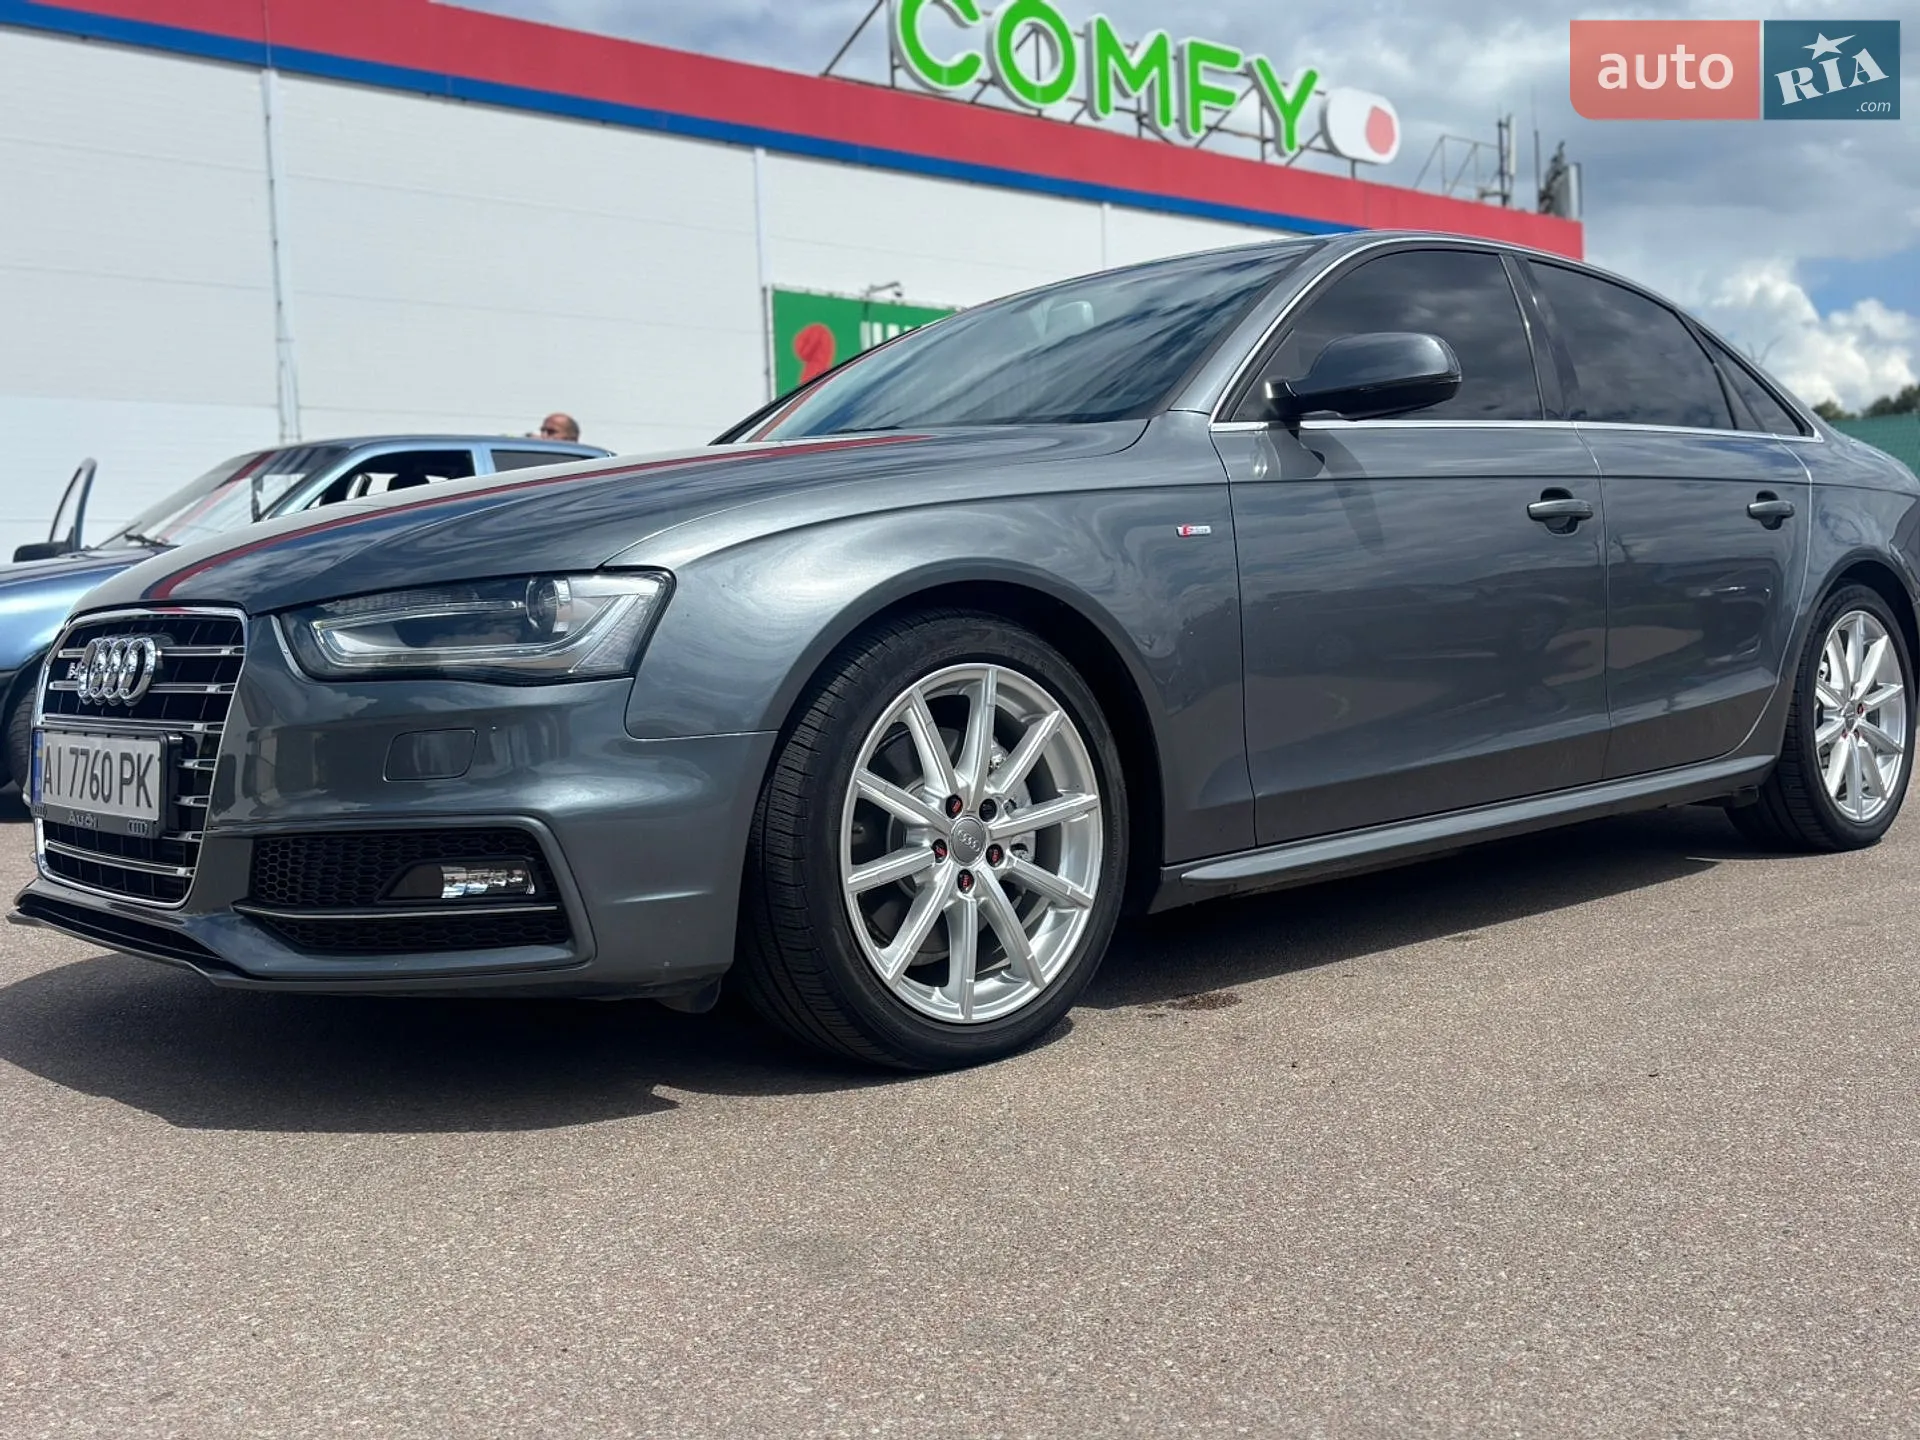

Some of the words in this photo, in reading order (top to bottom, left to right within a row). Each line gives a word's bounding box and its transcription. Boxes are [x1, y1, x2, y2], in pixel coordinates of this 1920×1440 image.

[892, 0, 1319, 154] COMFY
[42, 744, 62, 796] AI
[69, 747, 113, 804] 7760
[119, 752, 154, 808] PK
